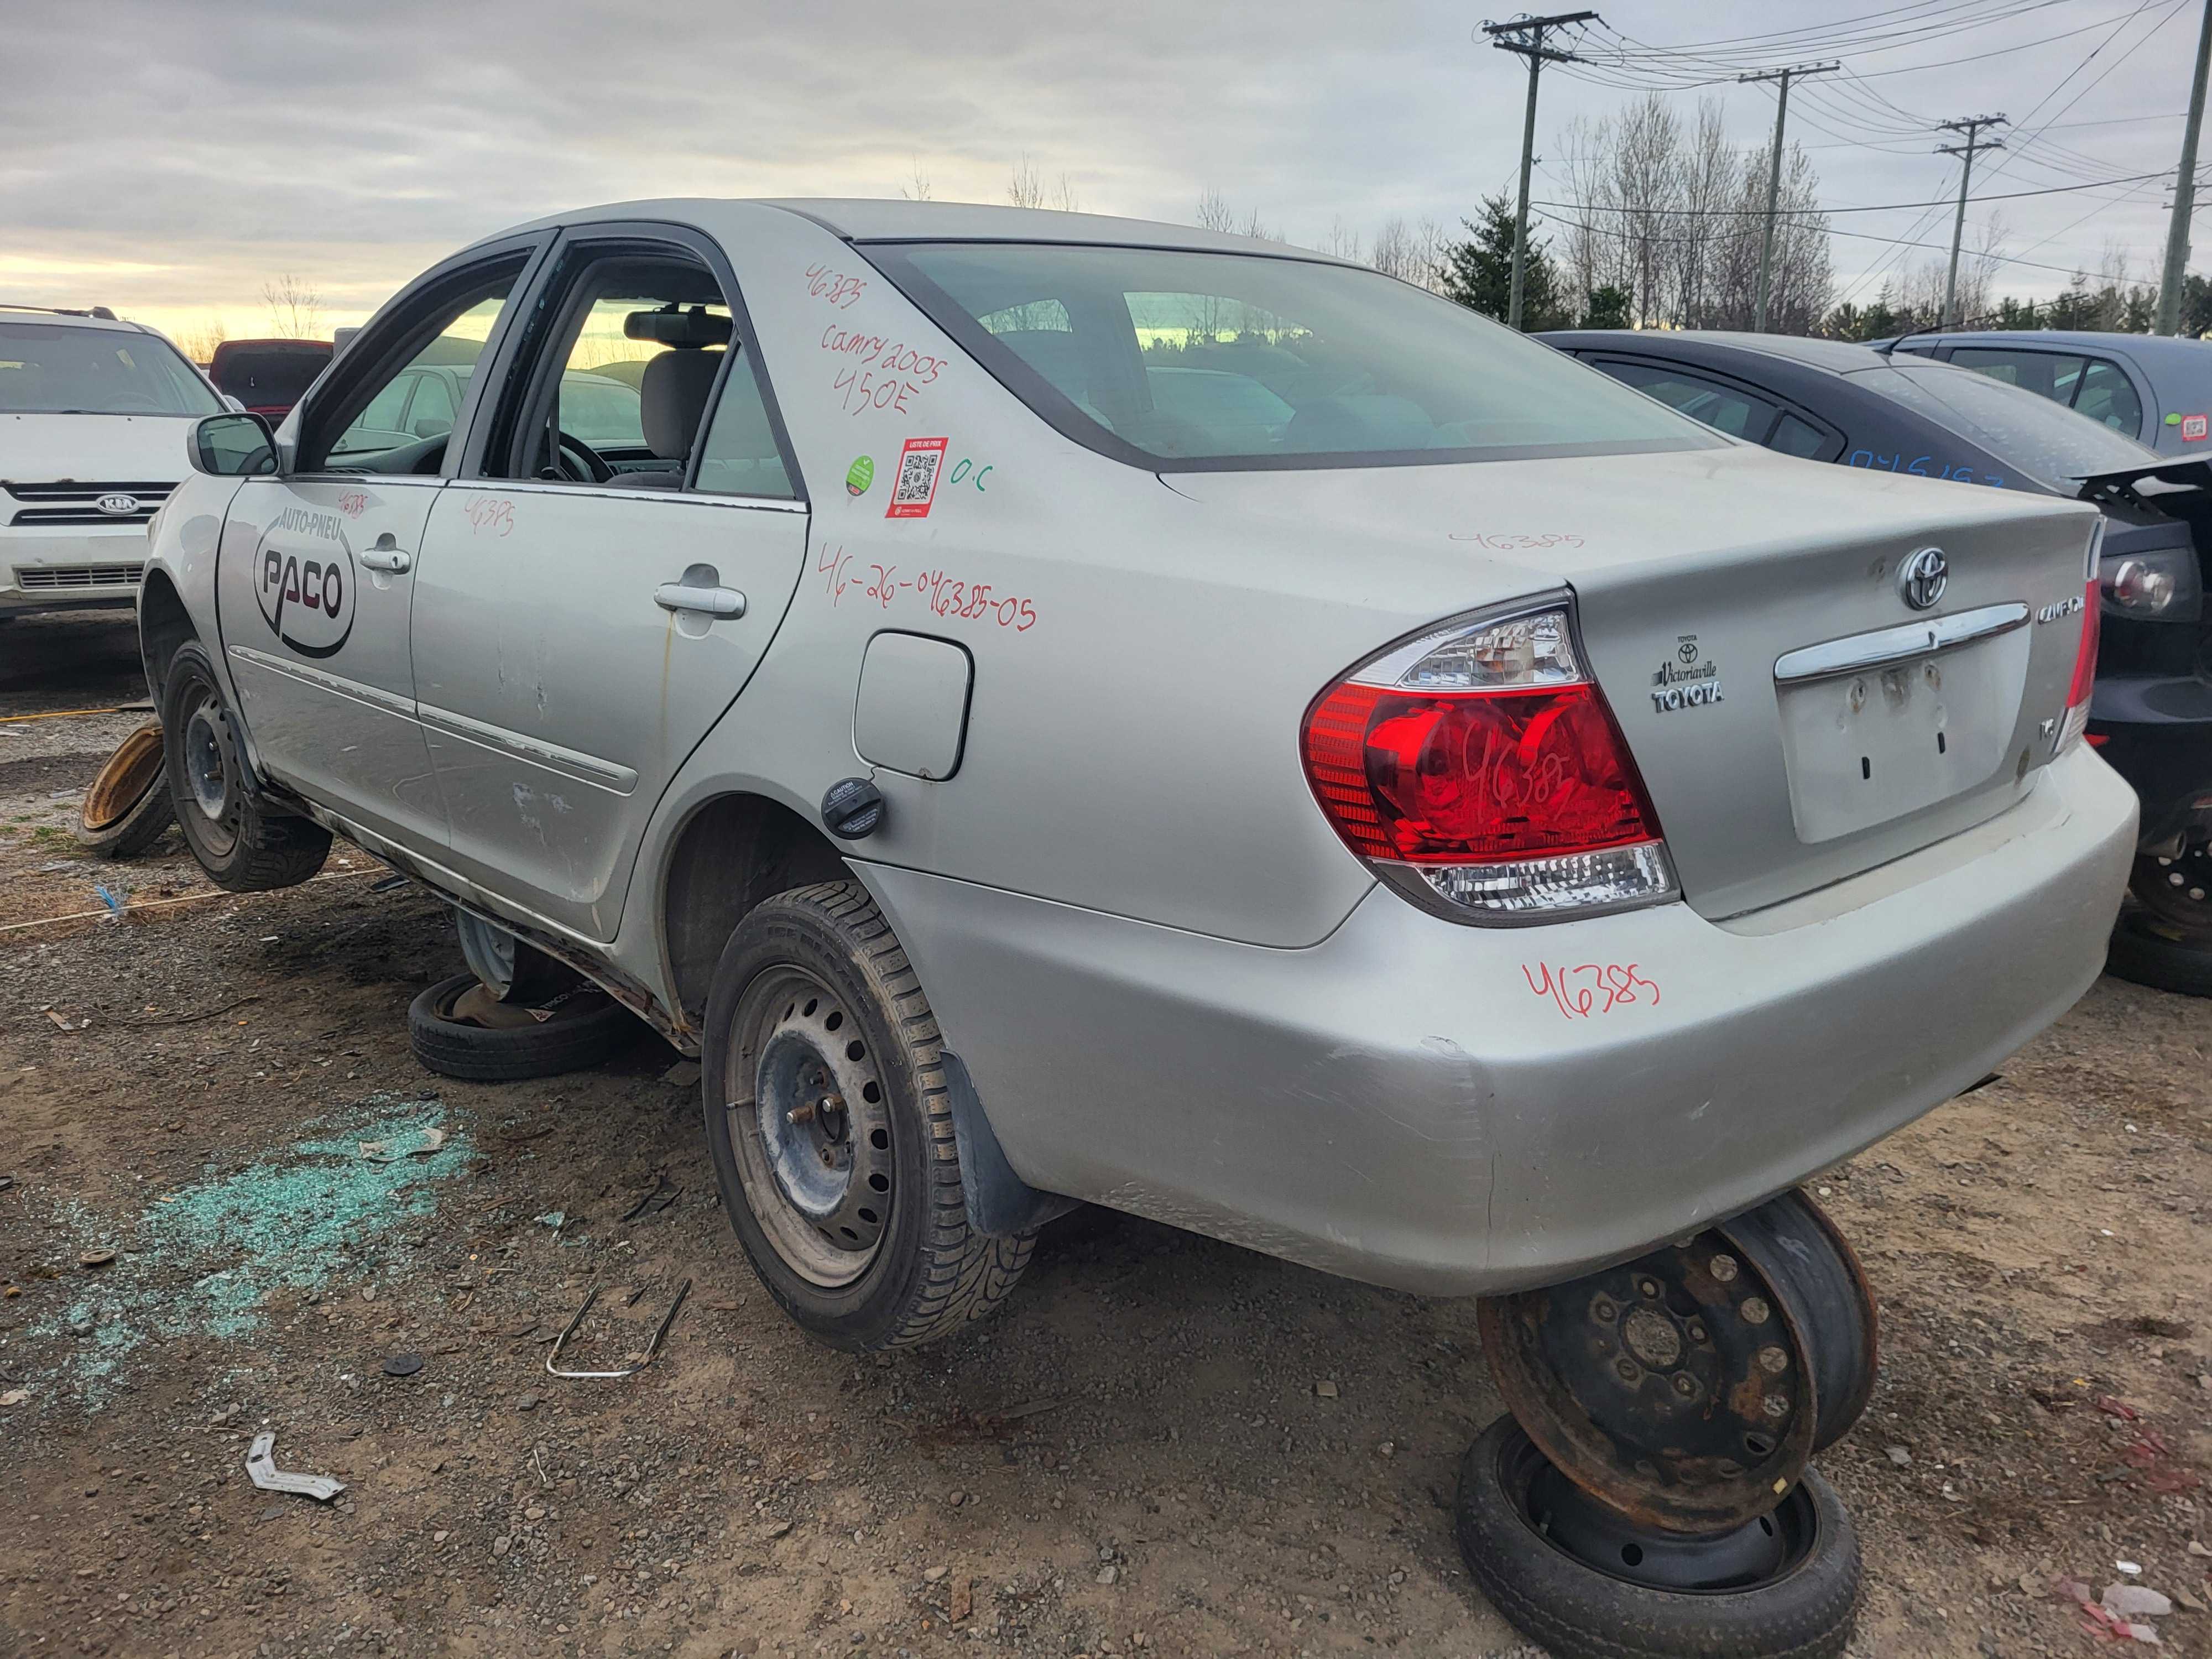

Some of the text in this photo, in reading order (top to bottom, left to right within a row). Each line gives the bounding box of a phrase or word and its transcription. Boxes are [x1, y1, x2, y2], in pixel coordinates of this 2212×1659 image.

[805, 262, 868, 310] 46385
[104, 499, 133, 509] KIA
[279, 507, 341, 541] AUTO-PNEU
[1448, 534, 1585, 550] 46385
[263, 550, 342, 625] PACO
[1677, 634, 1698, 643] TOYOTA
[1661, 660, 1717, 687] Victoriaville
[1651, 681, 1725, 713] TOYOTA
[1522, 962, 1660, 1019] 46385
